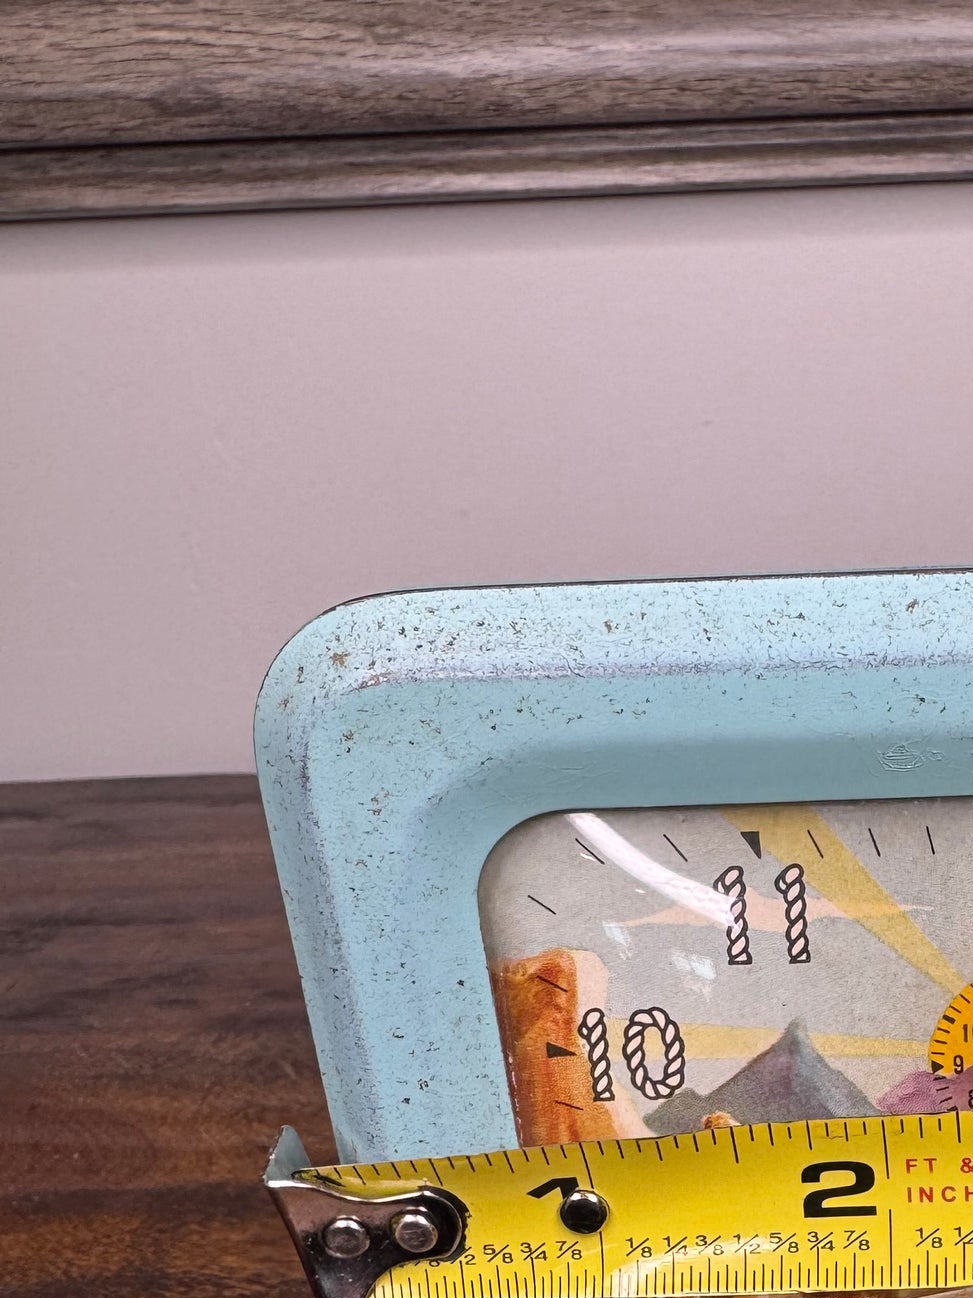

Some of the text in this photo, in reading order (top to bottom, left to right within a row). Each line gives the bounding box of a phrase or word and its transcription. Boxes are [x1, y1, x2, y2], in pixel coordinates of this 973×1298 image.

[713, 864, 811, 965] 11
[578, 1006, 686, 1101] 10
[953, 1055, 964, 1075] 9
[801, 1160, 878, 1218] 2
[905, 1157, 937, 1174] FT
[483, 1244, 514, 1264] 5/8
[520, 1242, 547, 1261] 3/4
[555, 1240, 583, 1260] 7/8
[625, 1236, 652, 1258] 1/8
[769, 1232, 799, 1253] 5/8
[807, 1231, 835, 1251] 3/4
[844, 1230, 870, 1250] 7/8
[915, 1227, 943, 1248] 1/8
